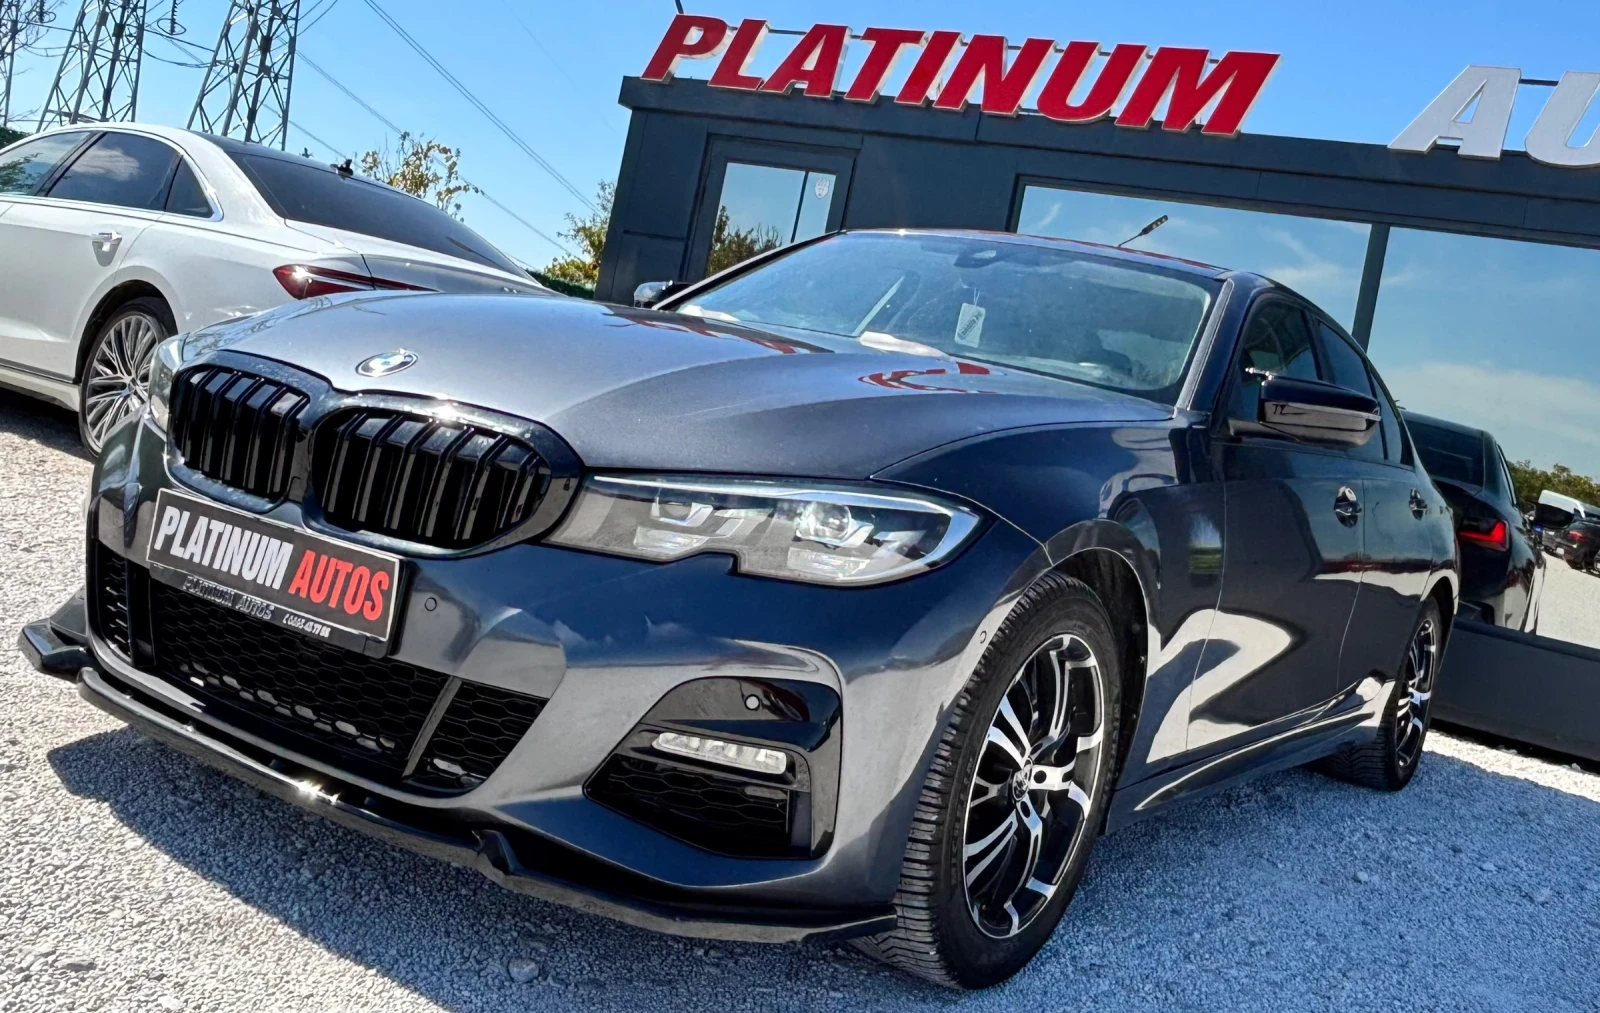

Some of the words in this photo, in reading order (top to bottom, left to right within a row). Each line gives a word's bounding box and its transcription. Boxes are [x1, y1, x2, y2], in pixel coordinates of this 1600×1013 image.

[641, 14, 1280, 136] PLATINUM
[154, 505, 294, 590] PLATINUM
[289, 549, 390, 621] AUTOS
[235, 595, 275, 621] AUTOS
